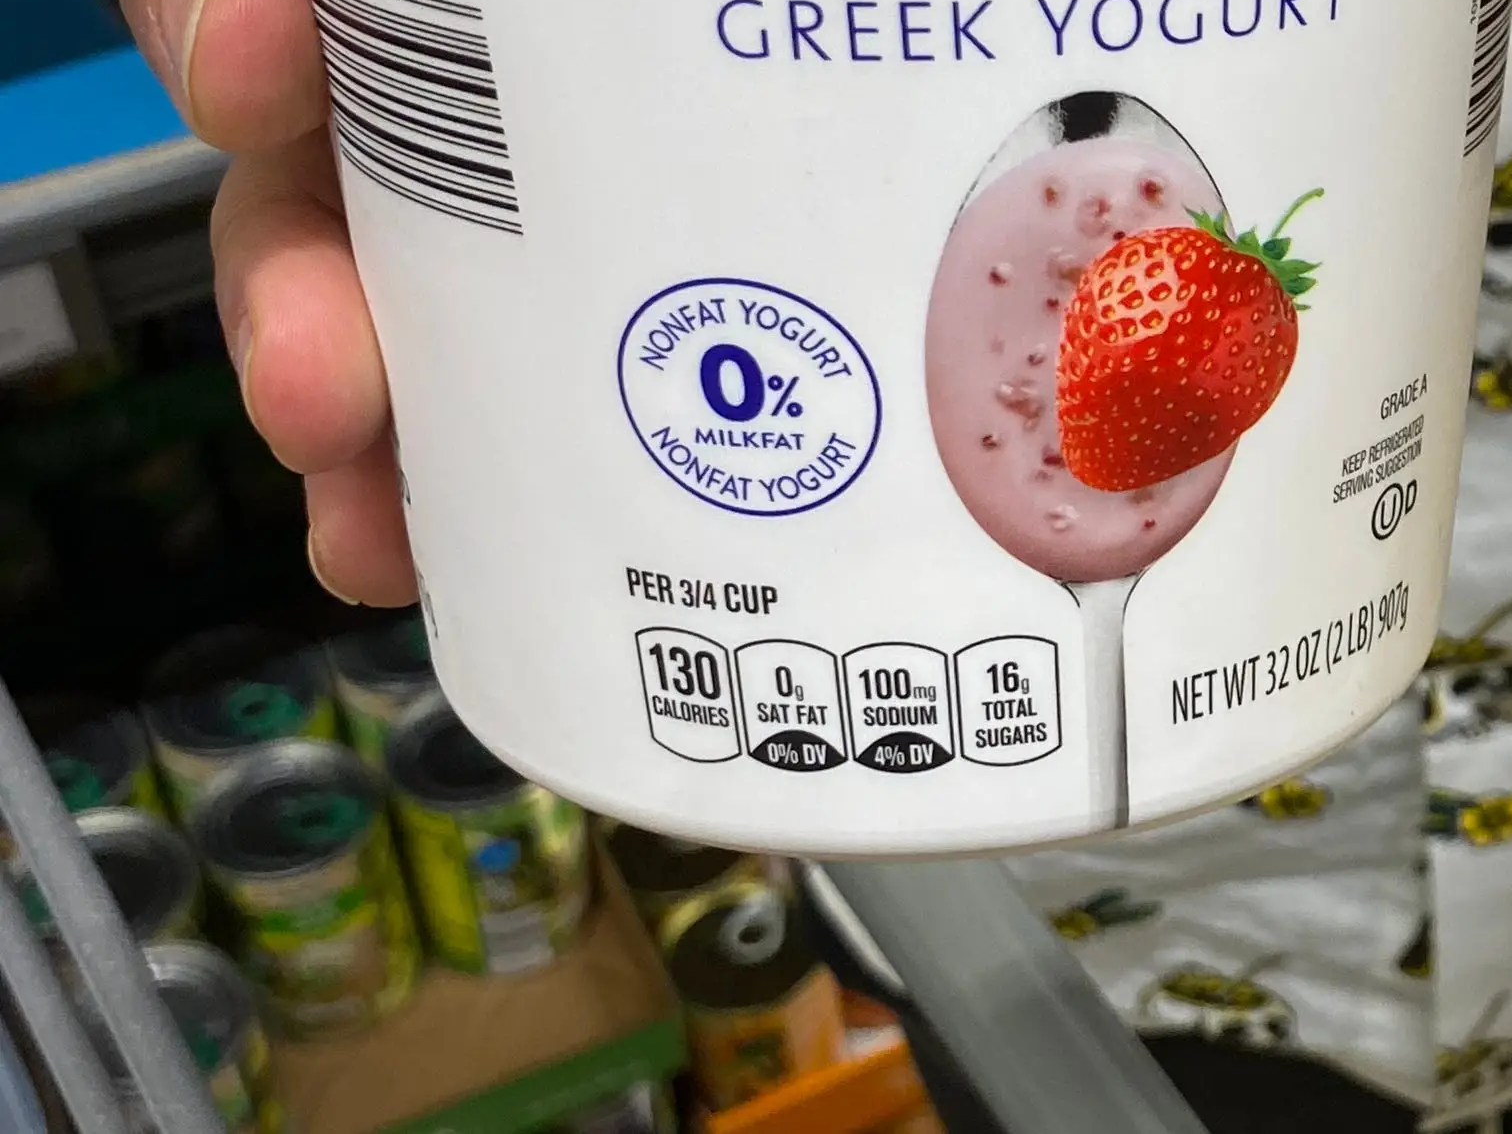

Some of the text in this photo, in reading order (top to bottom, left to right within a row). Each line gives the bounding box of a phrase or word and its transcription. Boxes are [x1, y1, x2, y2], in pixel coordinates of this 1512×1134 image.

[639, 298, 852, 377] NONFAT YOGURT
[700, 343, 803, 422] 0%
[1380, 373, 1428, 420] GRADE A
[695, 427, 804, 450] MILKFAT
[1342, 414, 1425, 477] KEEP REFRIGERATED
[651, 426, 856, 502] NONFAT YOGURT
[1333, 437, 1423, 504] SERVING SUGGESTION
[626, 567, 778, 615] PER 3/4 CUP
[1173, 580, 1409, 724] NET WT 32 OZ (2 LB) 907g
[649, 642, 721, 700] 130
[775, 665, 804, 702] 0g
[859, 668, 937, 702] 100mg
[986, 661, 1030, 695] 16g
[652, 695, 730, 728] CALORIES
[757, 703, 828, 726] SAT FAT
[863, 706, 938, 726] SODIUM
[982, 698, 1037, 721] TOTAL
[975, 723, 1047, 748] SUGARS
[767, 742, 827, 765] 0% DV
[874, 744, 934, 767] 4% DV
